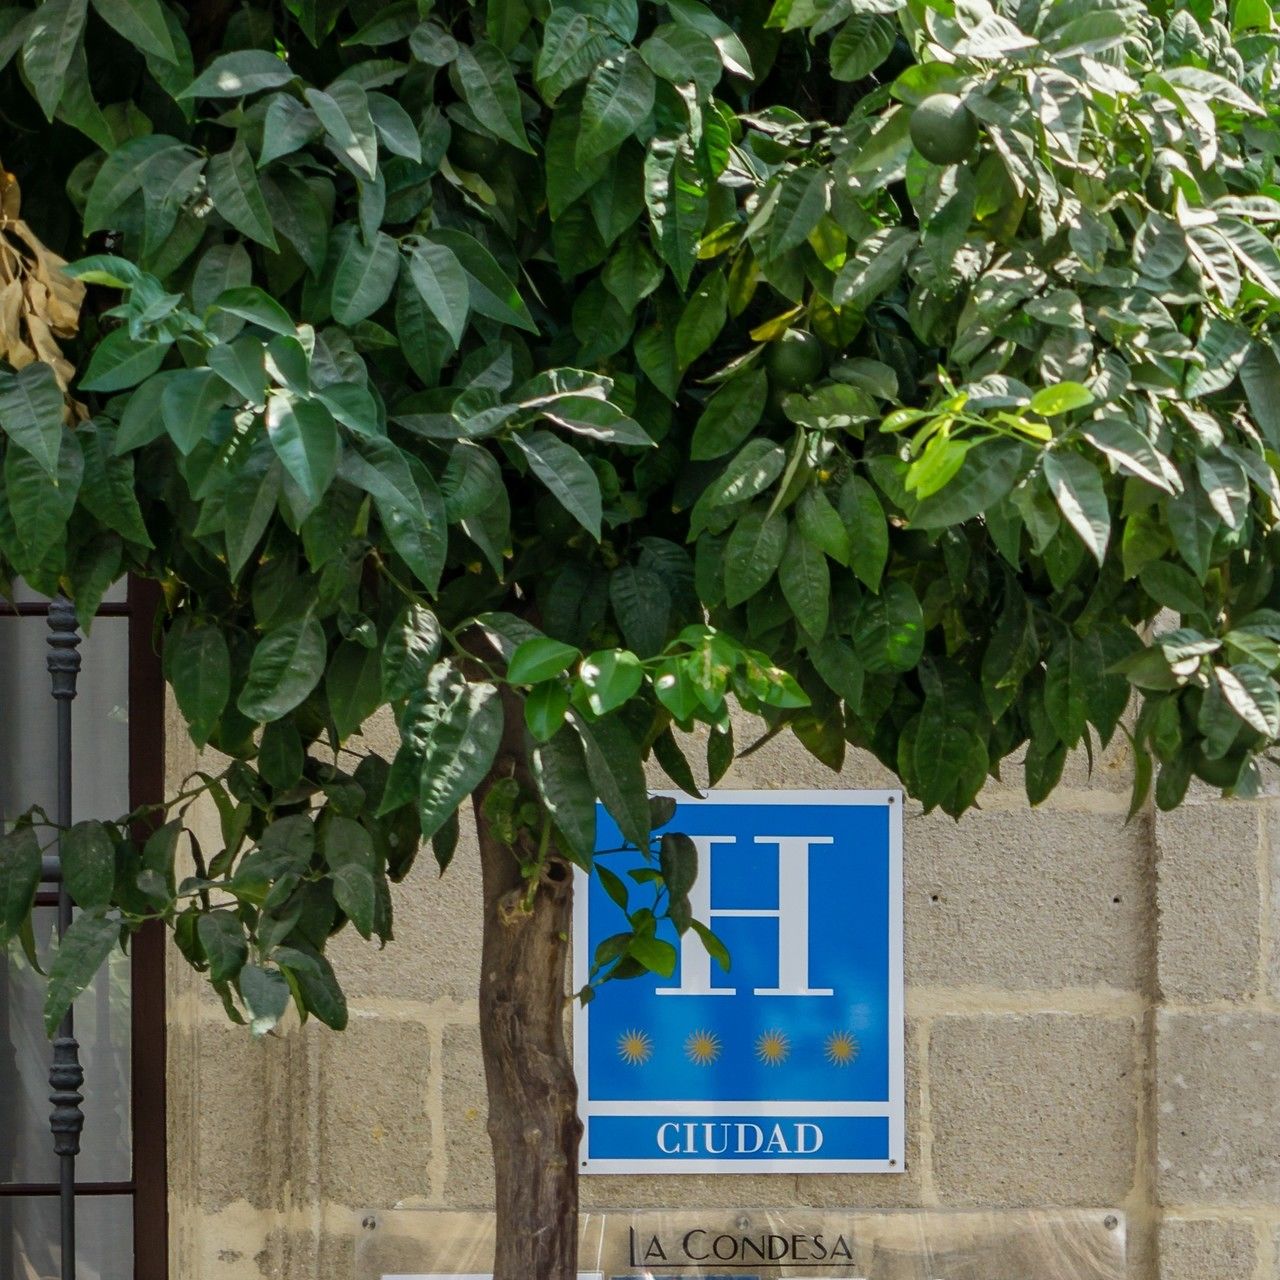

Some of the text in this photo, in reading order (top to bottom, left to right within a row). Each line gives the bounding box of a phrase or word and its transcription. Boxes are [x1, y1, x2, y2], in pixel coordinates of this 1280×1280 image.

[655, 836, 834, 996] H
[656, 1123, 824, 1154] CIUDAD
[682, 1229, 854, 1261] CONDESA
